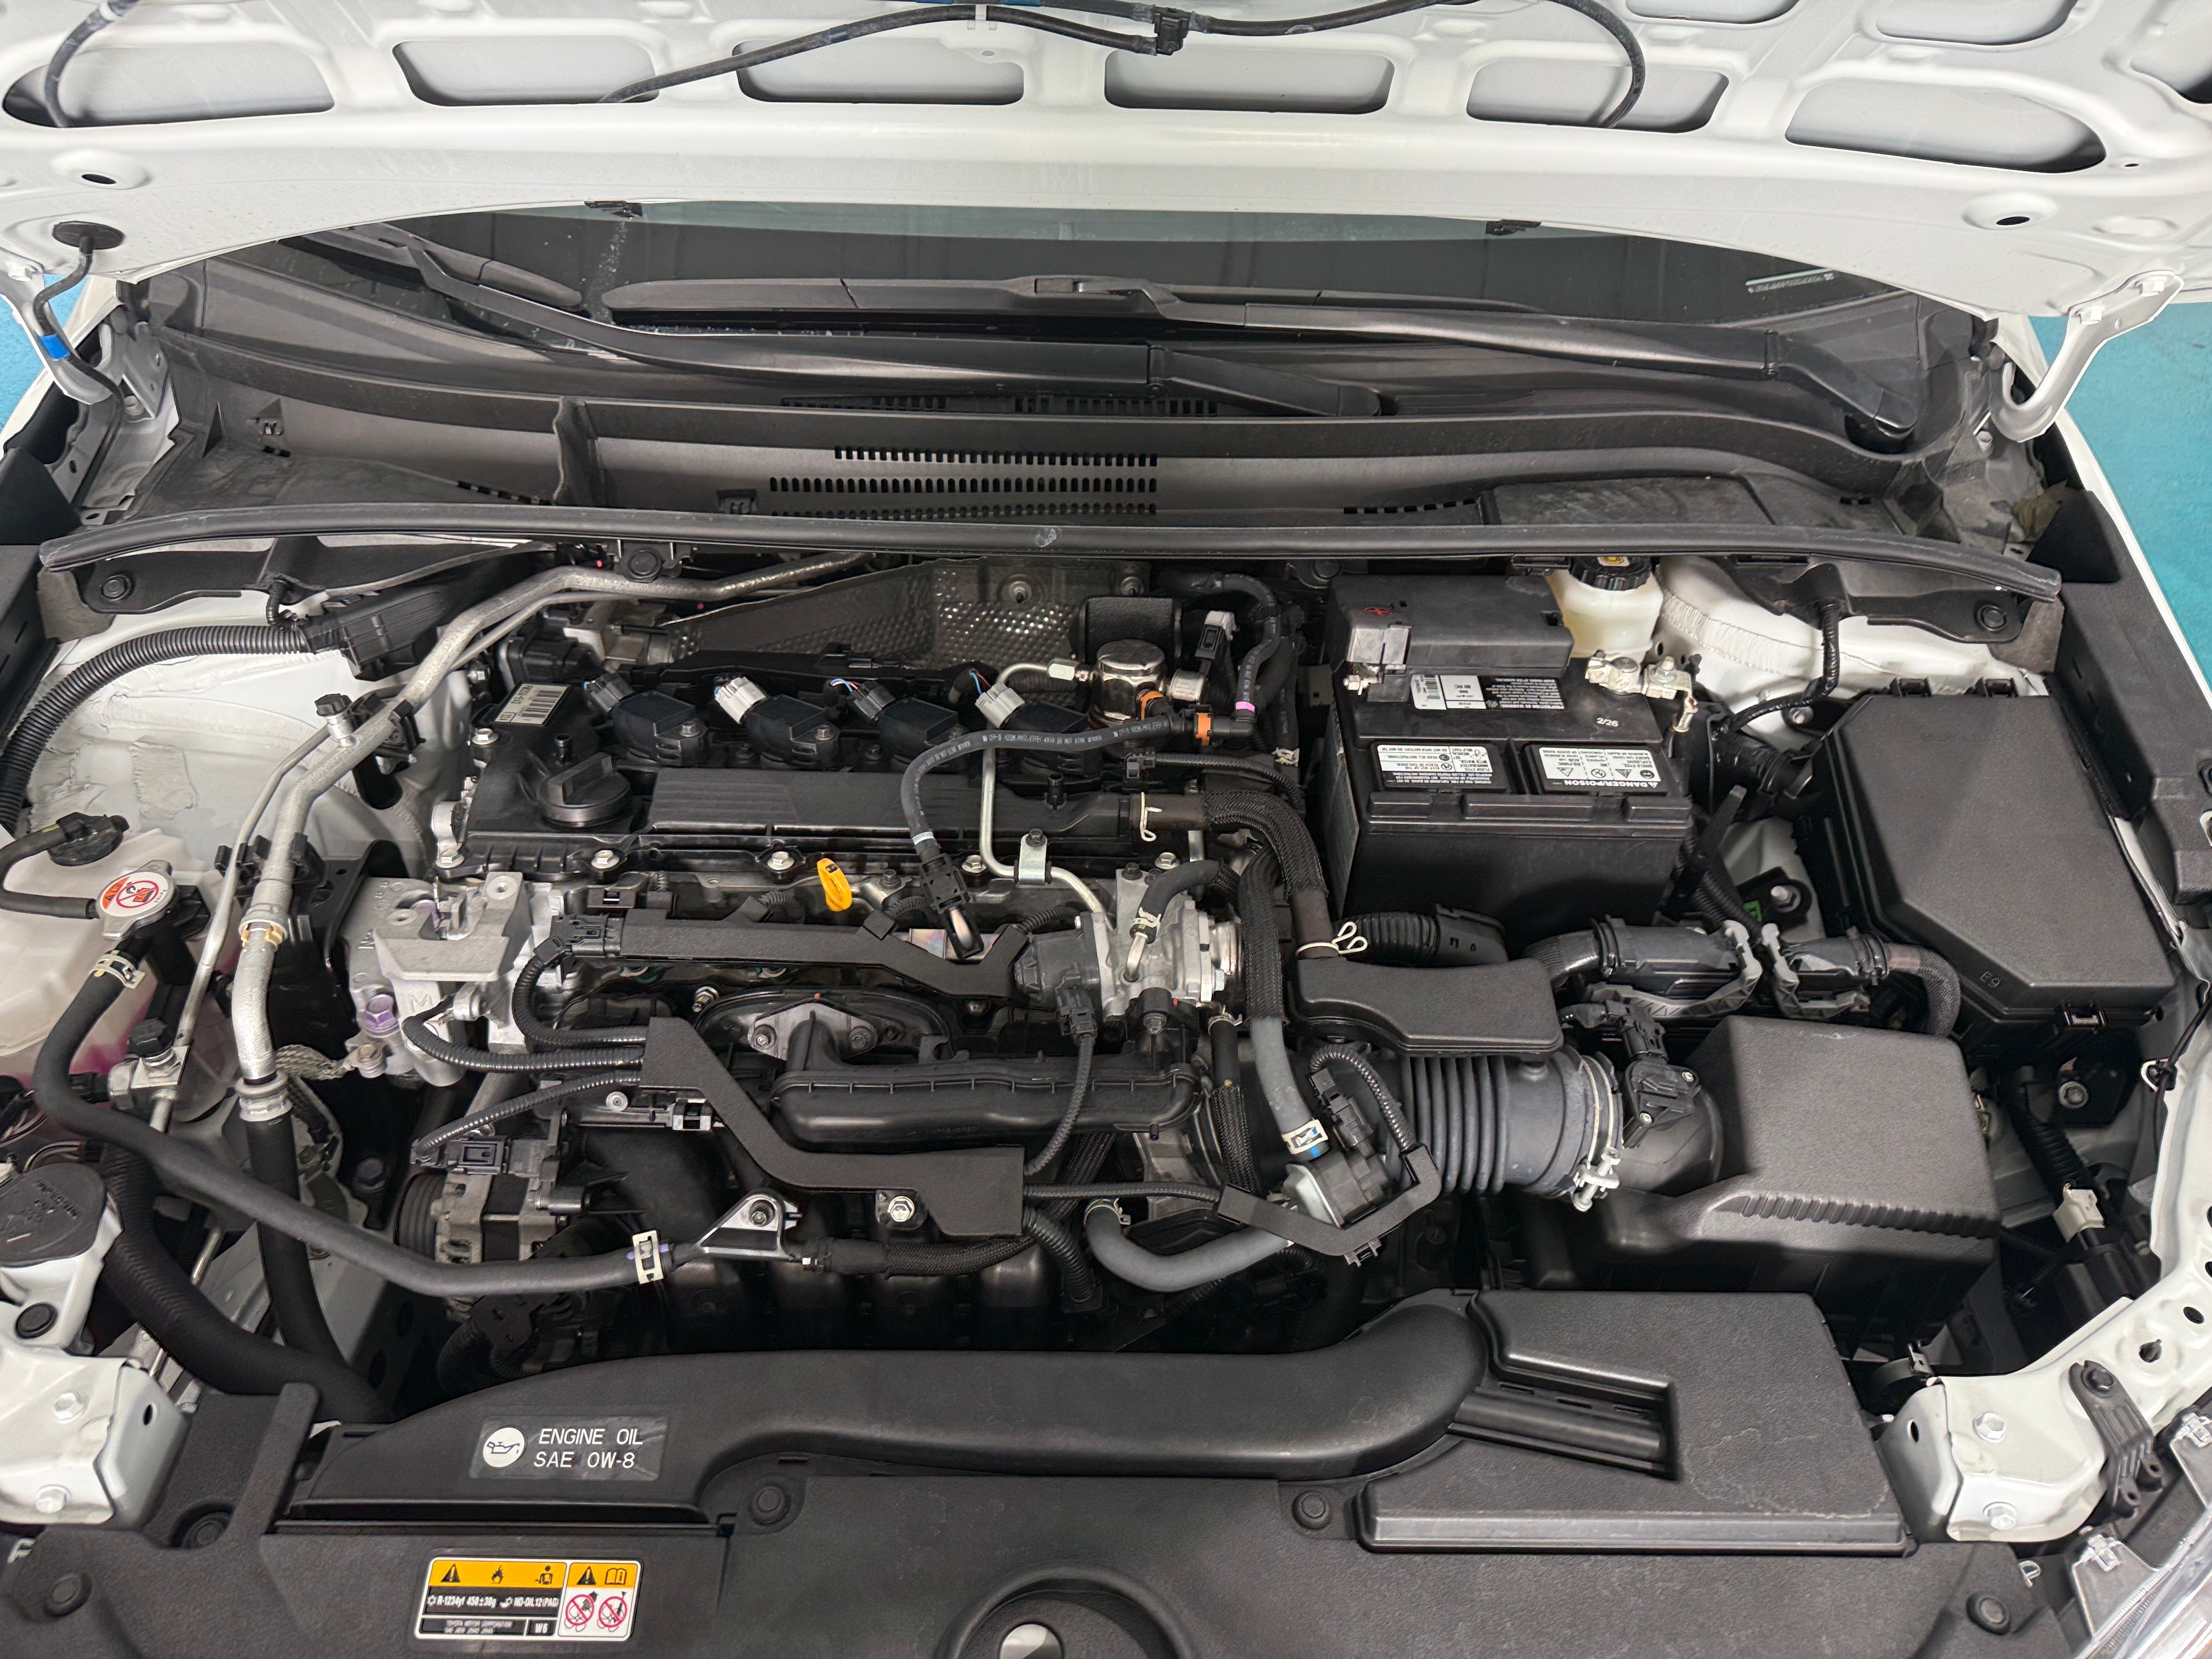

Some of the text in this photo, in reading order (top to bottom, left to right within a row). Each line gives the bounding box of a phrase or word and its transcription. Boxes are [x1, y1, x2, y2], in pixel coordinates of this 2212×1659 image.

[1596, 717, 1618, 727] 2/26
[1564, 780, 1648, 788] DANGER/POISON
[1979, 971, 2000, 988] E9
[539, 1427, 643, 1445] ENGINE OIL
[534, 1452, 635, 1469] SAE 0W-8
[437, 1596, 465, 1608] R-1234yf
[466, 1596, 496, 1608] 450±30g
